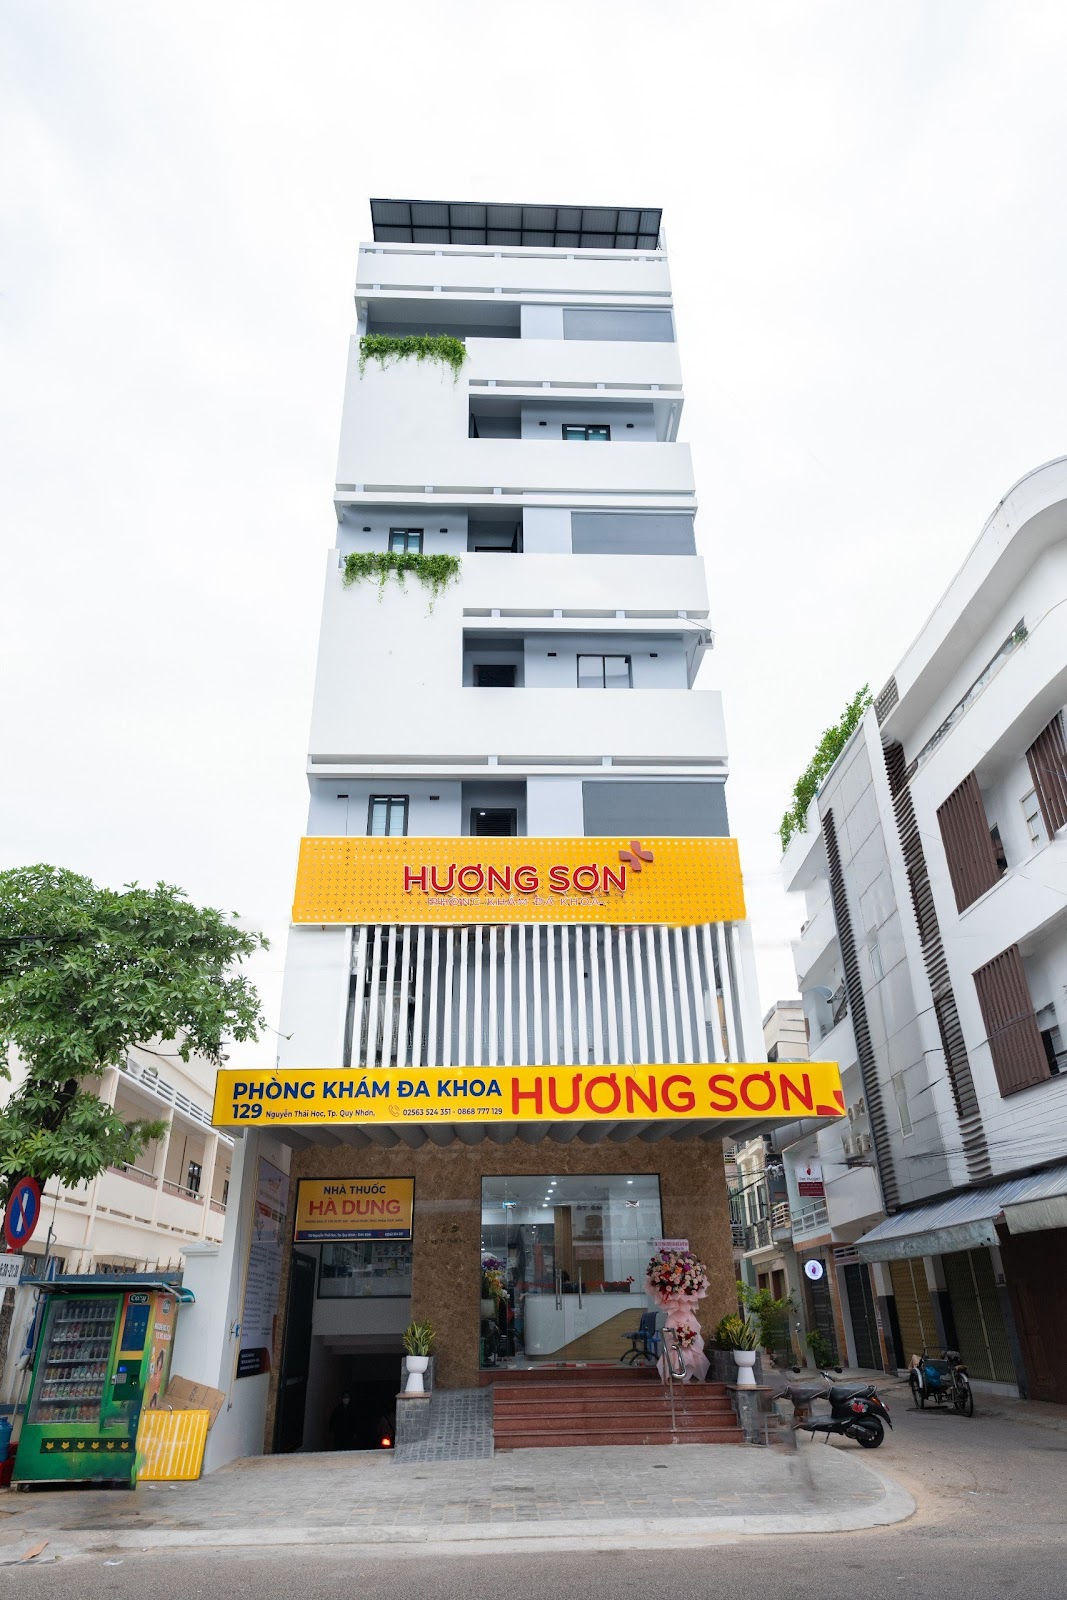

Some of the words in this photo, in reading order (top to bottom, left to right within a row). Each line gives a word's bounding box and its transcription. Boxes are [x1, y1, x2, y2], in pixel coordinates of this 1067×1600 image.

[403, 863, 539, 893] HƯƠNG
[549, 863, 627, 893] SƠN
[560, 896, 600, 906] KHOA
[232, 1077, 315, 1100] PHÒNG
[322, 1076, 390, 1098] KHÁM
[397, 1080, 430, 1098] ĐA
[437, 1079, 502, 1097] KHOA
[511, 1072, 696, 1115] HƯƠNG
[708, 1070, 813, 1113] SƠN
[232, 1103, 263, 1119] 129
[265, 1108, 292, 1119] Nguyễn
[294, 1108, 309, 1118] Thái
[310, 1109, 326, 1119] Học,
[328, 1109, 338, 1119] Tp.
[339, 1109, 354, 1119] Quy
[403, 1108, 424, 1116] 02563
[426, 1108, 439, 1116] 524
[440, 1108, 451, 1116] 351
[457, 1107, 475, 1116] 0868
[477, 1107, 490, 1115] 777
[491, 1107, 503, 1115] 129
[323, 1183, 347, 1195] NHÀ
[349, 1182, 386, 1194] THUỐC
[308, 1196, 338, 1216] HÀ
[341, 1199, 401, 1216] DUNG
